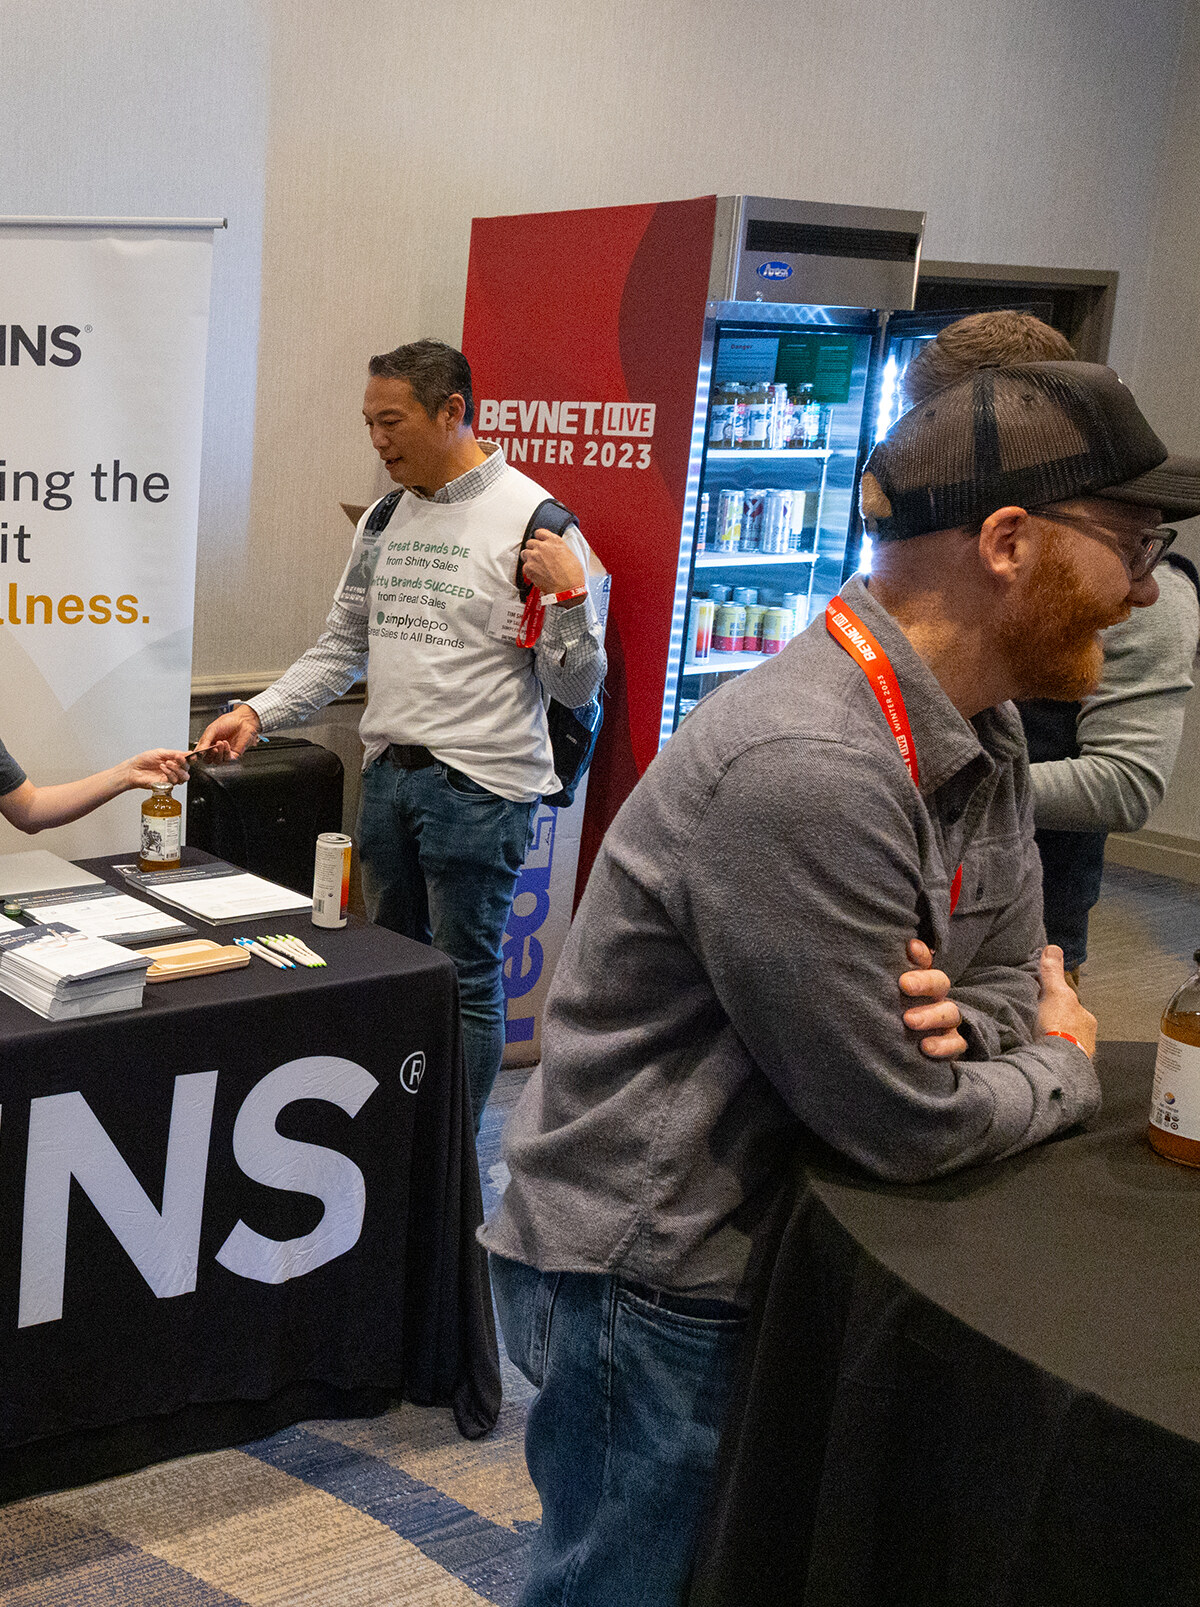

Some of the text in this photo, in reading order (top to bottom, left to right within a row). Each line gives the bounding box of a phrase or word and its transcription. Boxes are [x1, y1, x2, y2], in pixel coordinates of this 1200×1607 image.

[478, 399, 653, 435] BEVNET LIVE
[583, 441, 652, 470] 2023
[90, 459, 171, 503] the
[387, 540, 471, 559] Great Brands DIE
[386, 556, 459, 573] from Shitty Sales
[391, 576, 423, 589] Brands
[423, 579, 475, 600] SUCCEED
[377, 591, 397, 602] from
[398, 592, 419, 601] Great
[420, 595, 447, 610] Sales
[385, 612, 449, 633] simplydepo
[380, 628, 399, 640] Sales
[400, 631, 409, 641] to
[410, 632, 423, 643] All
[425, 634, 465, 650] Brands
[840, 623, 876, 662] BEVNET
[877, 675, 890, 696] 2023
[887, 697, 901, 732] WINTER
